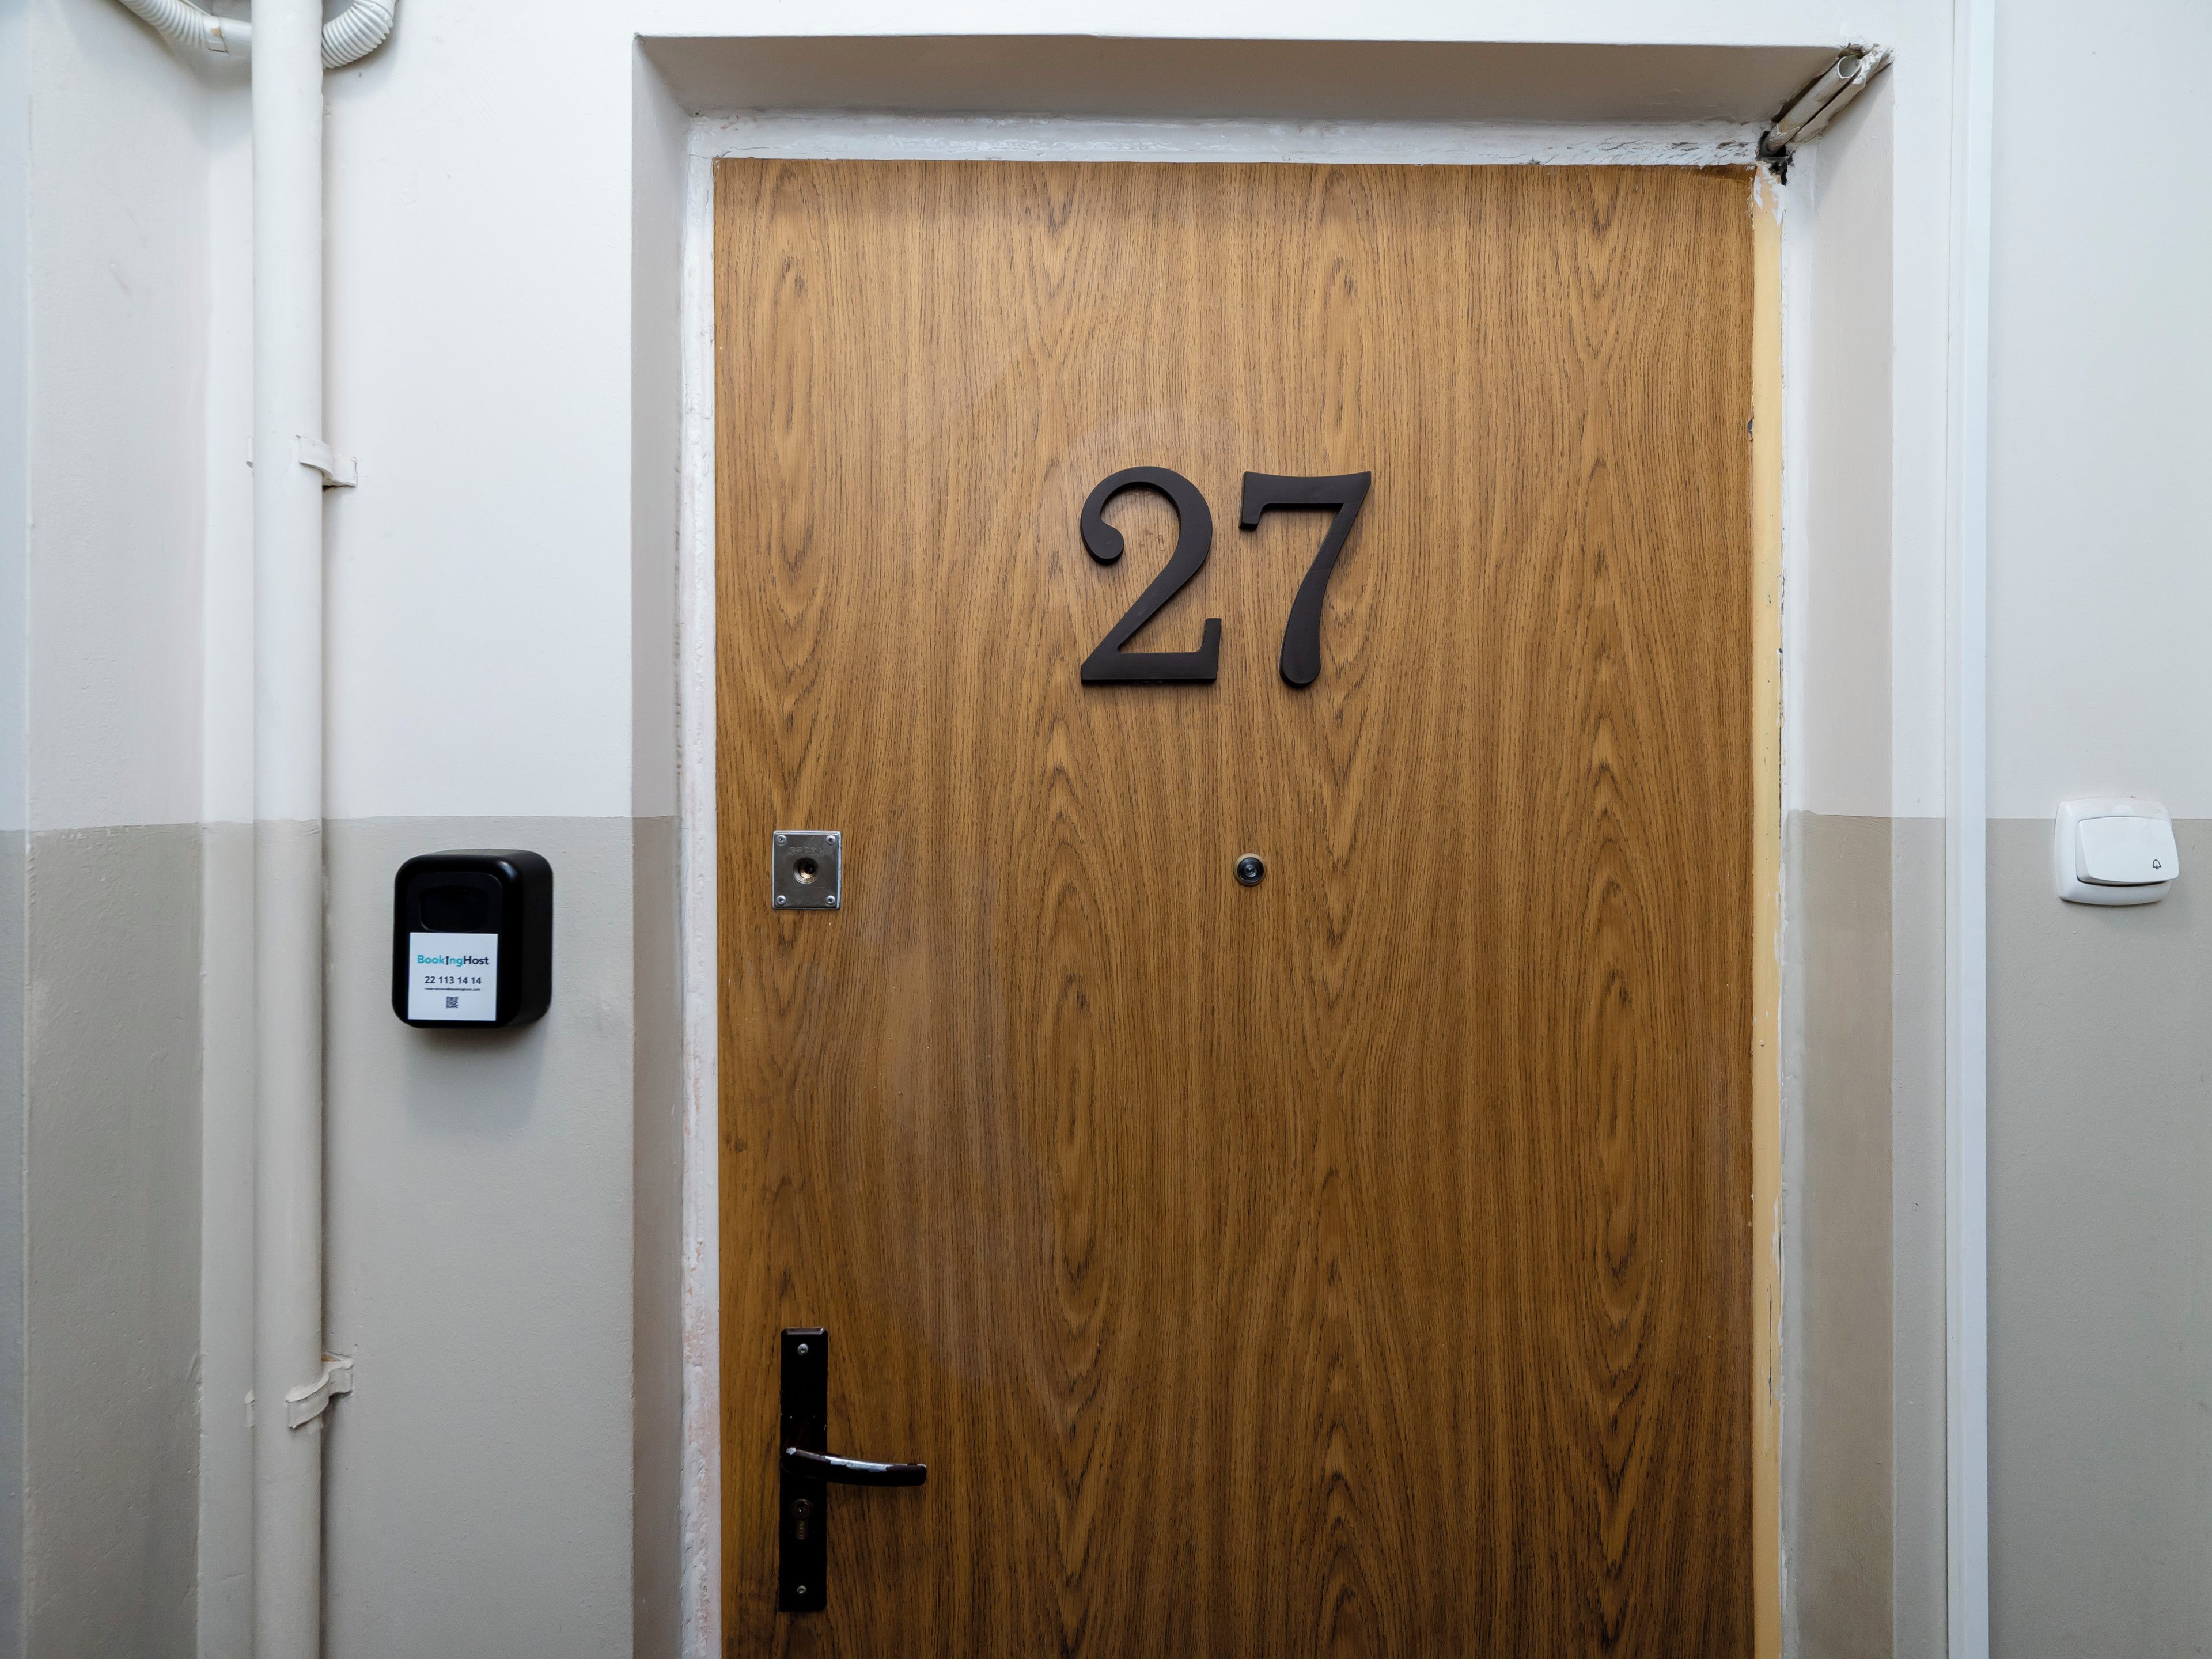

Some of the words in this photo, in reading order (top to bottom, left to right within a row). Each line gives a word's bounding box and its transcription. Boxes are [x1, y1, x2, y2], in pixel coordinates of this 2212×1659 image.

[1080, 465, 1372, 688] 27
[425, 976, 435, 984] 22
[457, 976, 468, 984] 14
[471, 976, 482, 984] 14
